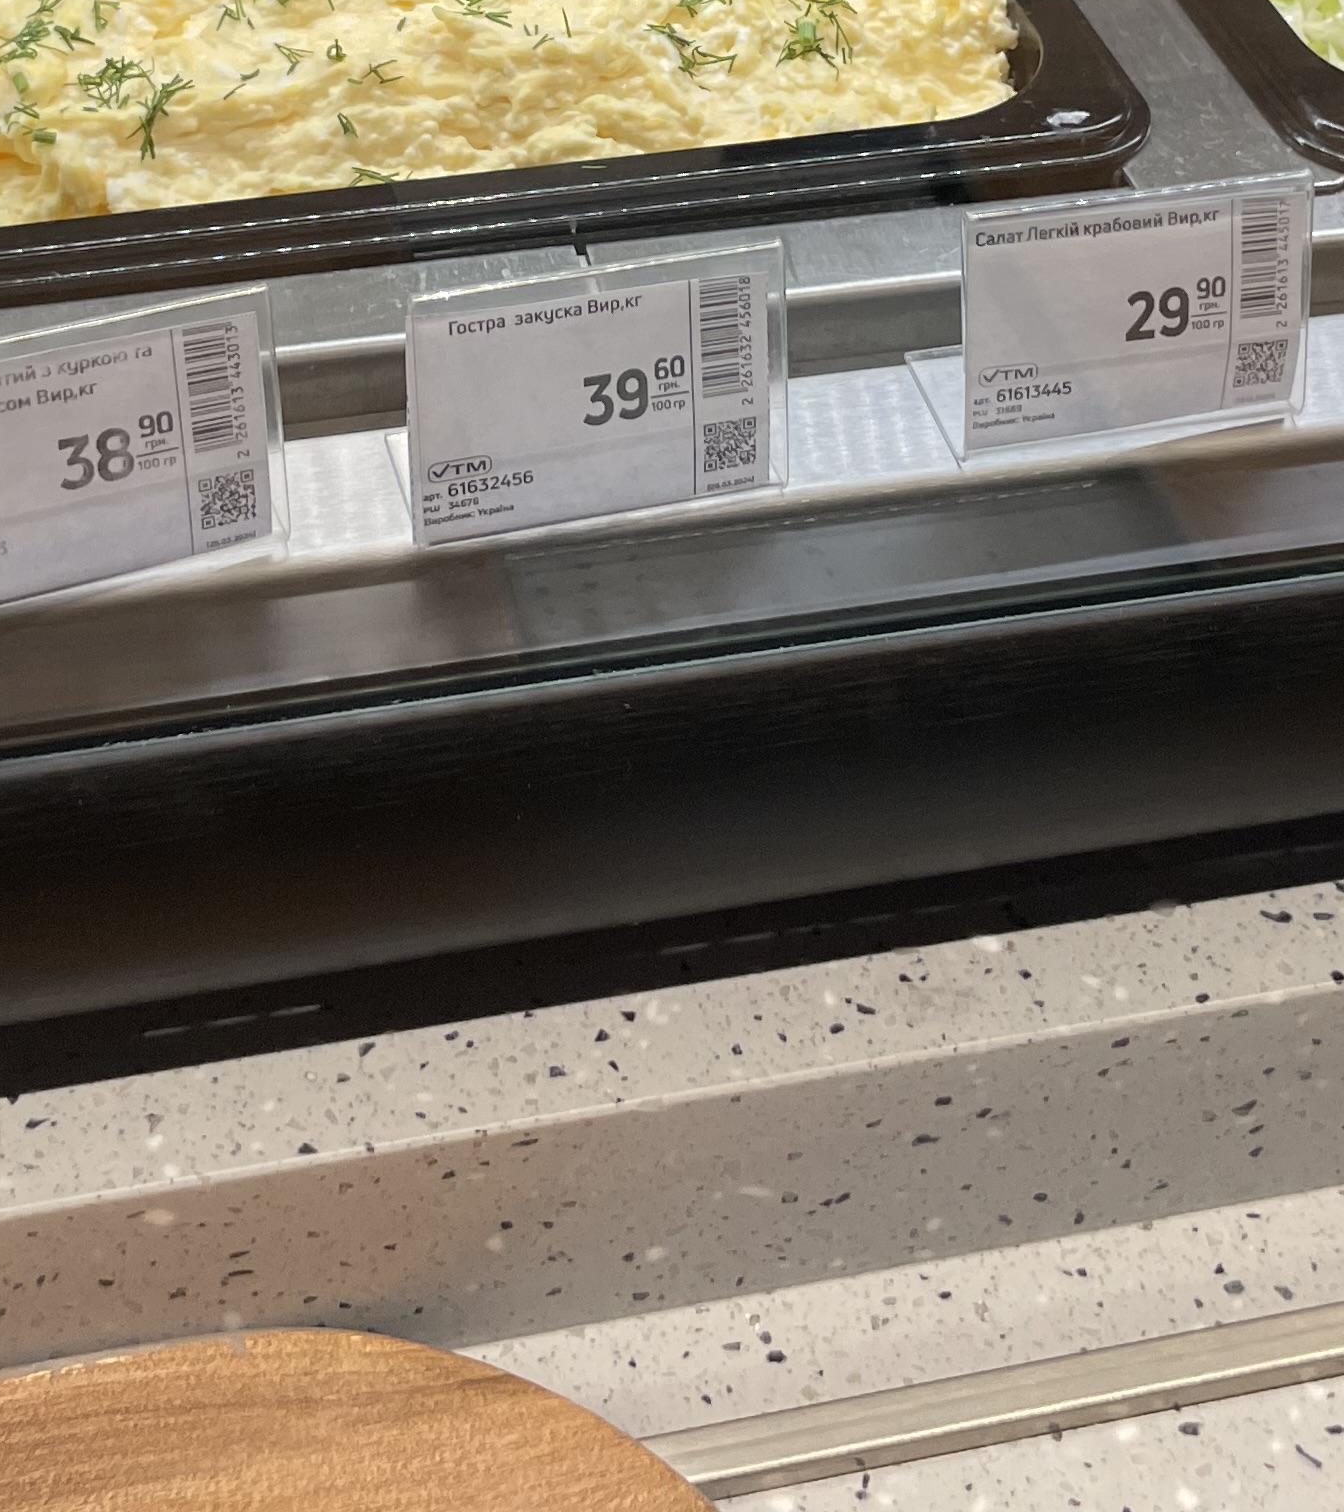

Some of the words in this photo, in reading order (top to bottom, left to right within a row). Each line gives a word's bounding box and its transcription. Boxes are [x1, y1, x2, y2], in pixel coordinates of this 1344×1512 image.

[975, 232, 1023, 247] Салат
[1026, 222, 1079, 241] Легкій
[1083, 214, 1162, 238] крабовий
[1168, 209, 1219, 226] Вир,кг
[448, 317, 506, 336] Гостра
[514, 304, 582, 325] закуска
[587, 294, 642, 315] Вир,кг
[1125, 287, 1189, 341] 29
[1197, 276, 1225, 299] 90
[57, 349, 128, 377] куркою
[36, 381, 98, 406] Вир,кг
[583, 367, 649, 426] 39
[654, 355, 685, 380] 60
[997, 381, 1071, 402] 61613445
[58, 427, 134, 490] 38
[138, 411, 174, 438] 90
[448, 469, 533, 497] 61632456
